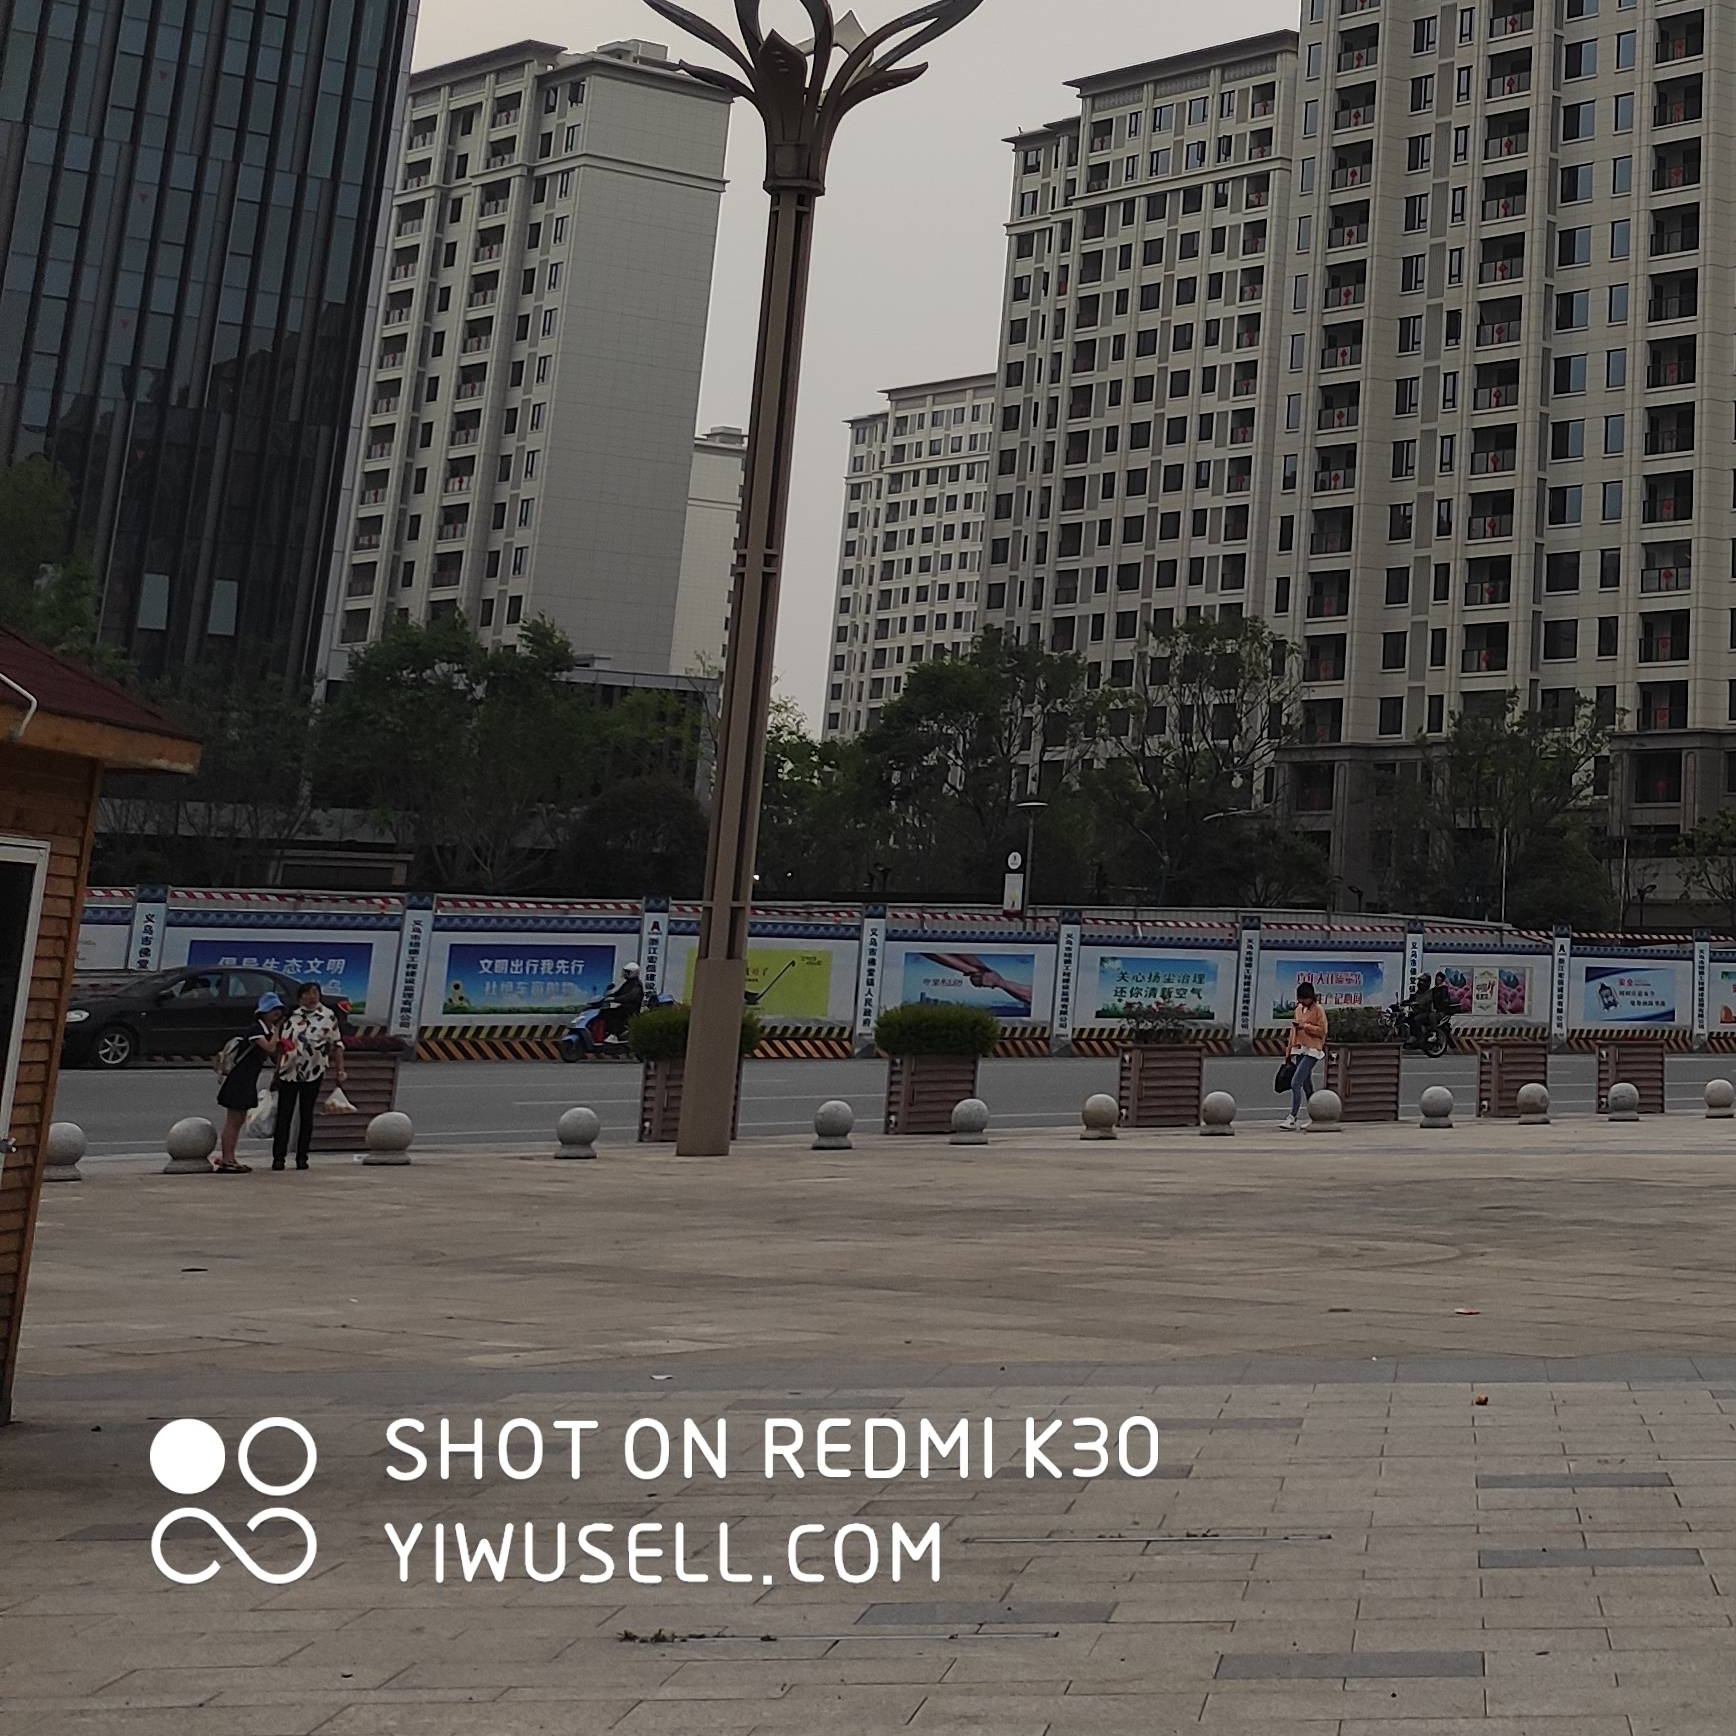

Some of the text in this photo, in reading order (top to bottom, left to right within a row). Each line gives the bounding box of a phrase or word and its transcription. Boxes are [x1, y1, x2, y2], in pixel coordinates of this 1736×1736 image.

[478, 959, 585, 976] 文明出行我先行
[1116, 972, 1206, 985] 关心扬尘治理
[1113, 986, 1203, 1000] 还你清新空气
